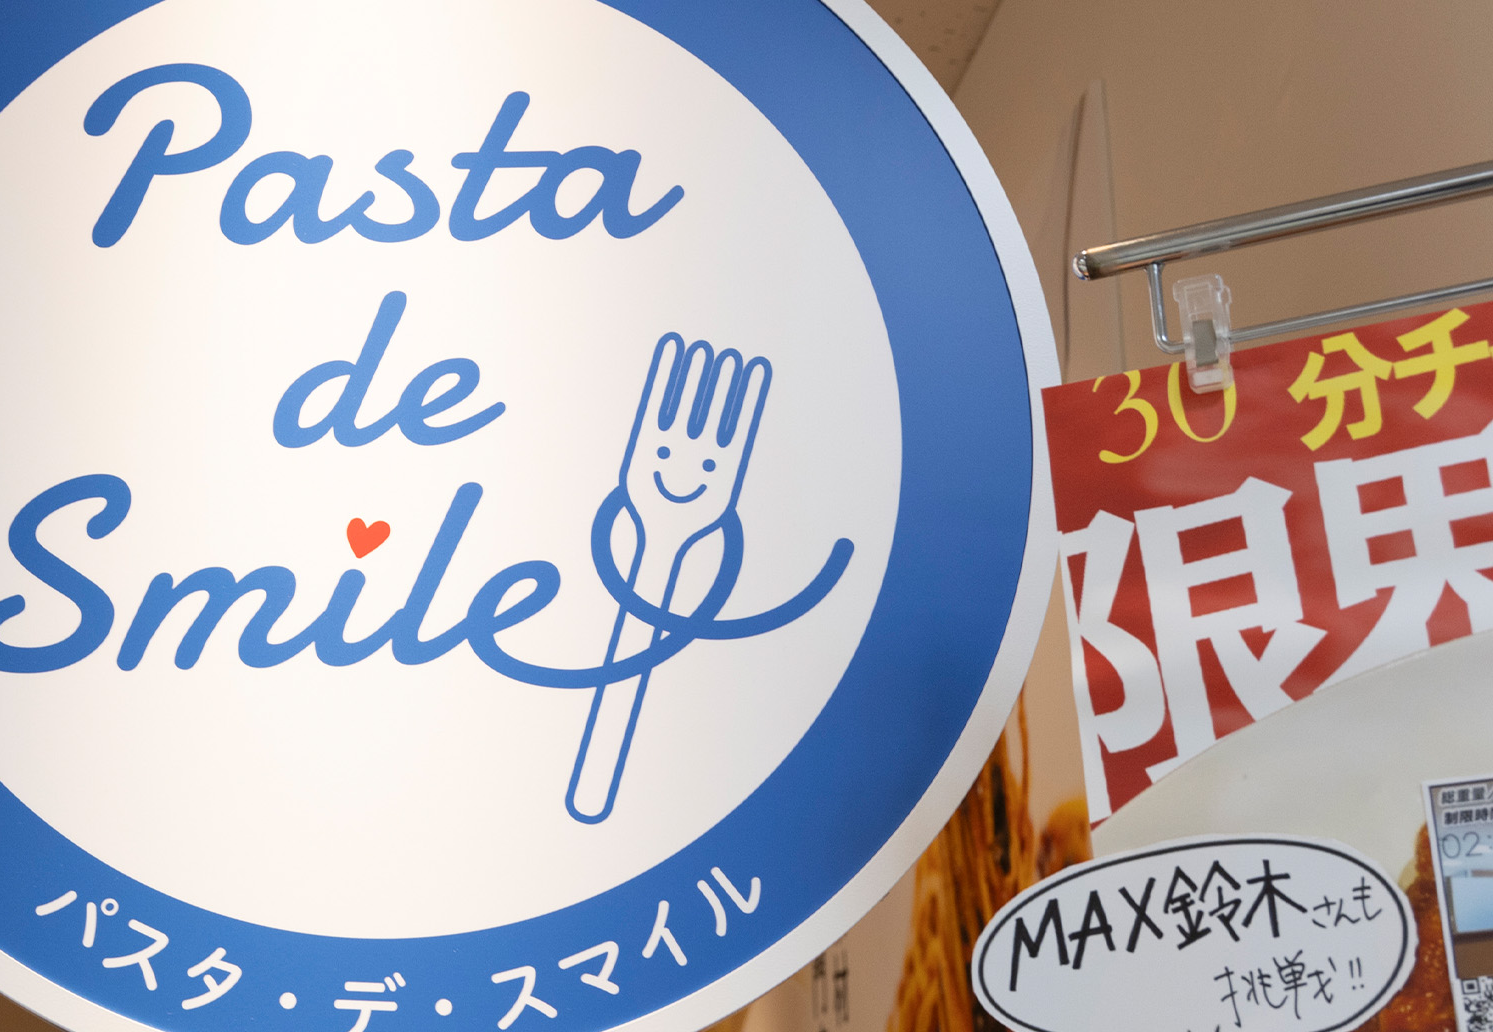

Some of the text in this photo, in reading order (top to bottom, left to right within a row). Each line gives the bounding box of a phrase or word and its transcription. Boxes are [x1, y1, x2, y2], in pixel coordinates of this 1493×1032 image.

[83, 63, 685, 248] Pasta
[273, 290, 506, 449] de
[1445, 808, 1493, 825] 制限時
